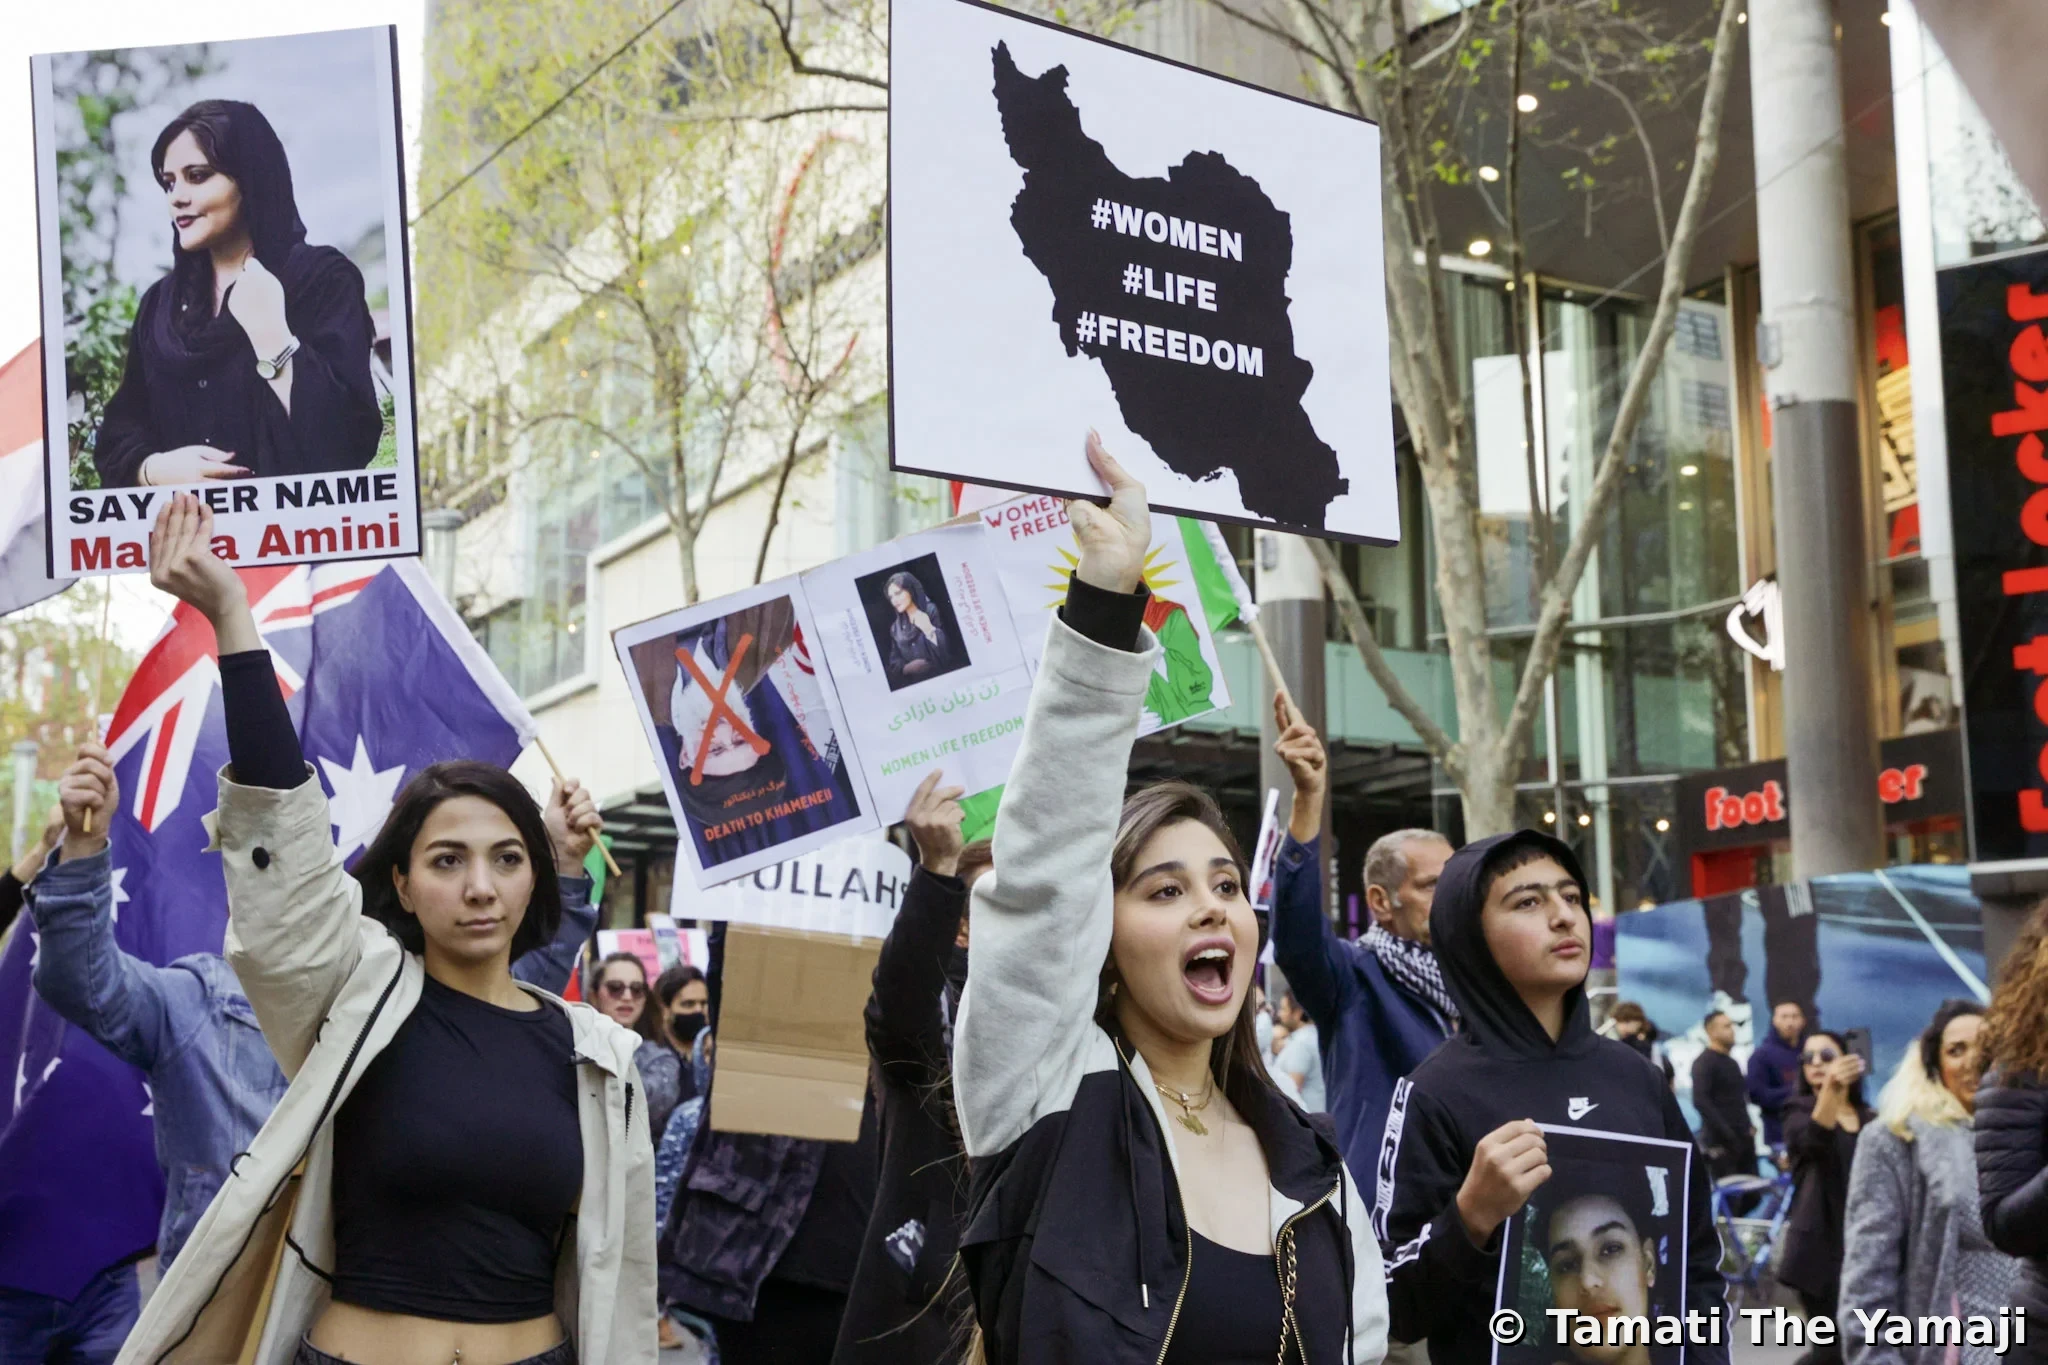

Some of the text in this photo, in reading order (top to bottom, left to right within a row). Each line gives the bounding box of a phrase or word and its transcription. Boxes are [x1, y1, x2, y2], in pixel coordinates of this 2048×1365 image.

[1091, 198, 1243, 262] #WOMEN
[1122, 263, 1218, 312] #LIFE
[1076, 311, 1264, 377] #FREEDOM
[69, 492, 156, 525] SAY
[276, 473, 398, 510] NAME
[70, 512, 400, 571] Maa Amini
[881, 715, 1025, 776] WOMEN LIFE FREEDOM
[704, 818, 747, 842] DEATH
[746, 812, 764, 826] TO
